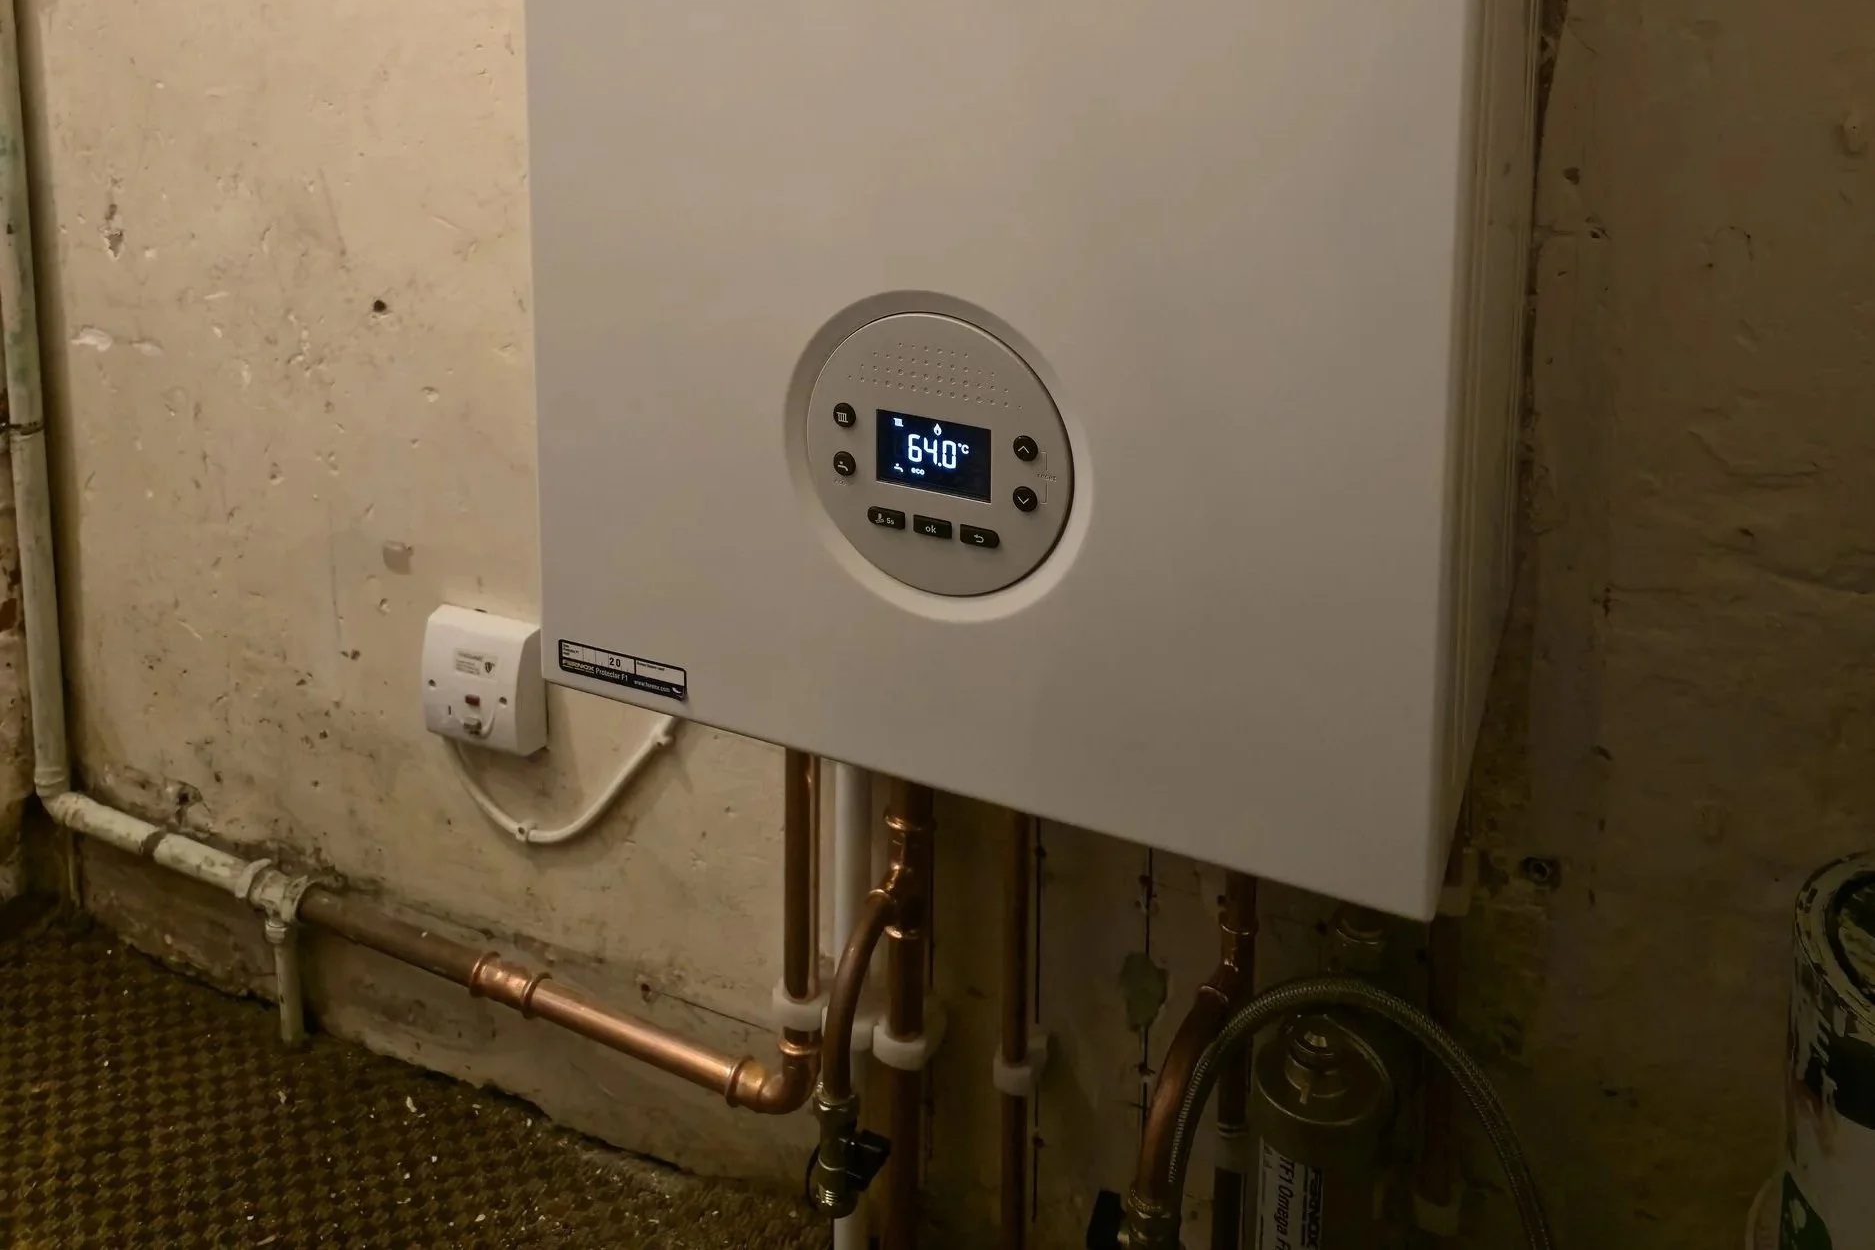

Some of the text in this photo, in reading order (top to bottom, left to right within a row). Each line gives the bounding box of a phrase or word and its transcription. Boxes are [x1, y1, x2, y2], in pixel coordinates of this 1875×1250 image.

[911, 467, 925, 476] eco
[886, 517, 895, 525] 5s
[925, 525, 936, 534] ok
[595, 667, 620, 680] Protector
[621, 673, 628, 681] F1
[1279, 1156, 1295, 1185] TF1
[1274, 1184, 1294, 1236] Omega
